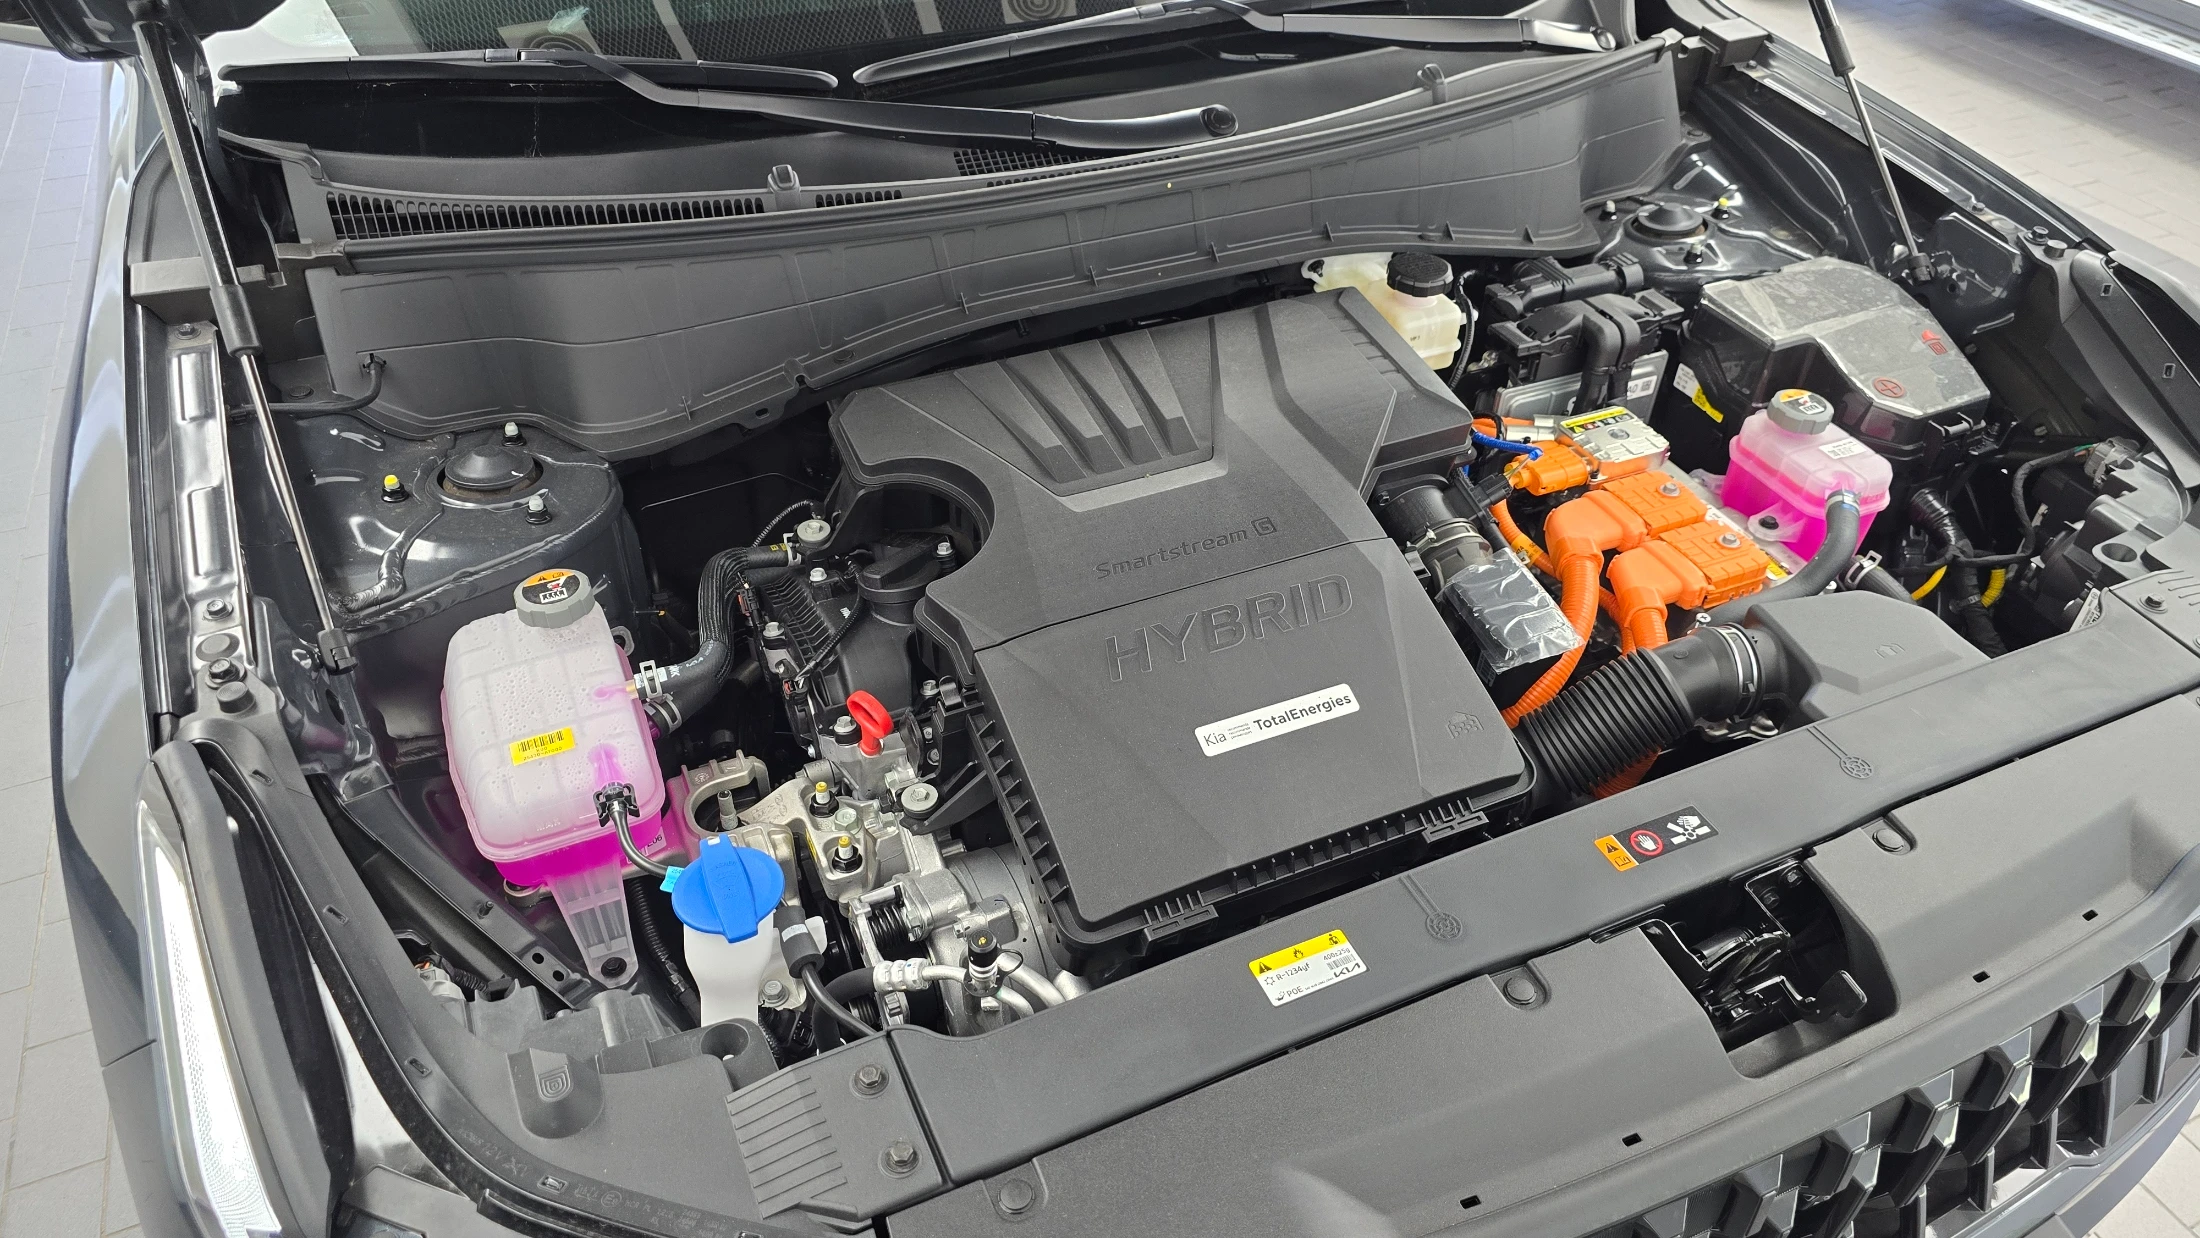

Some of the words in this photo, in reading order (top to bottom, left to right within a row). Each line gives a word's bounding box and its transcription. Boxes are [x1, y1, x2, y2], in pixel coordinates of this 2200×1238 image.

[1094, 528, 1248, 579] Smartstream
[1105, 573, 1353, 682] HYBRID
[1203, 731, 1227, 746] Kia
[1253, 694, 1352, 731] TotalEnergies
[1275, 962, 1310, 981] R-1234yf
[1286, 985, 1304, 997] POE
